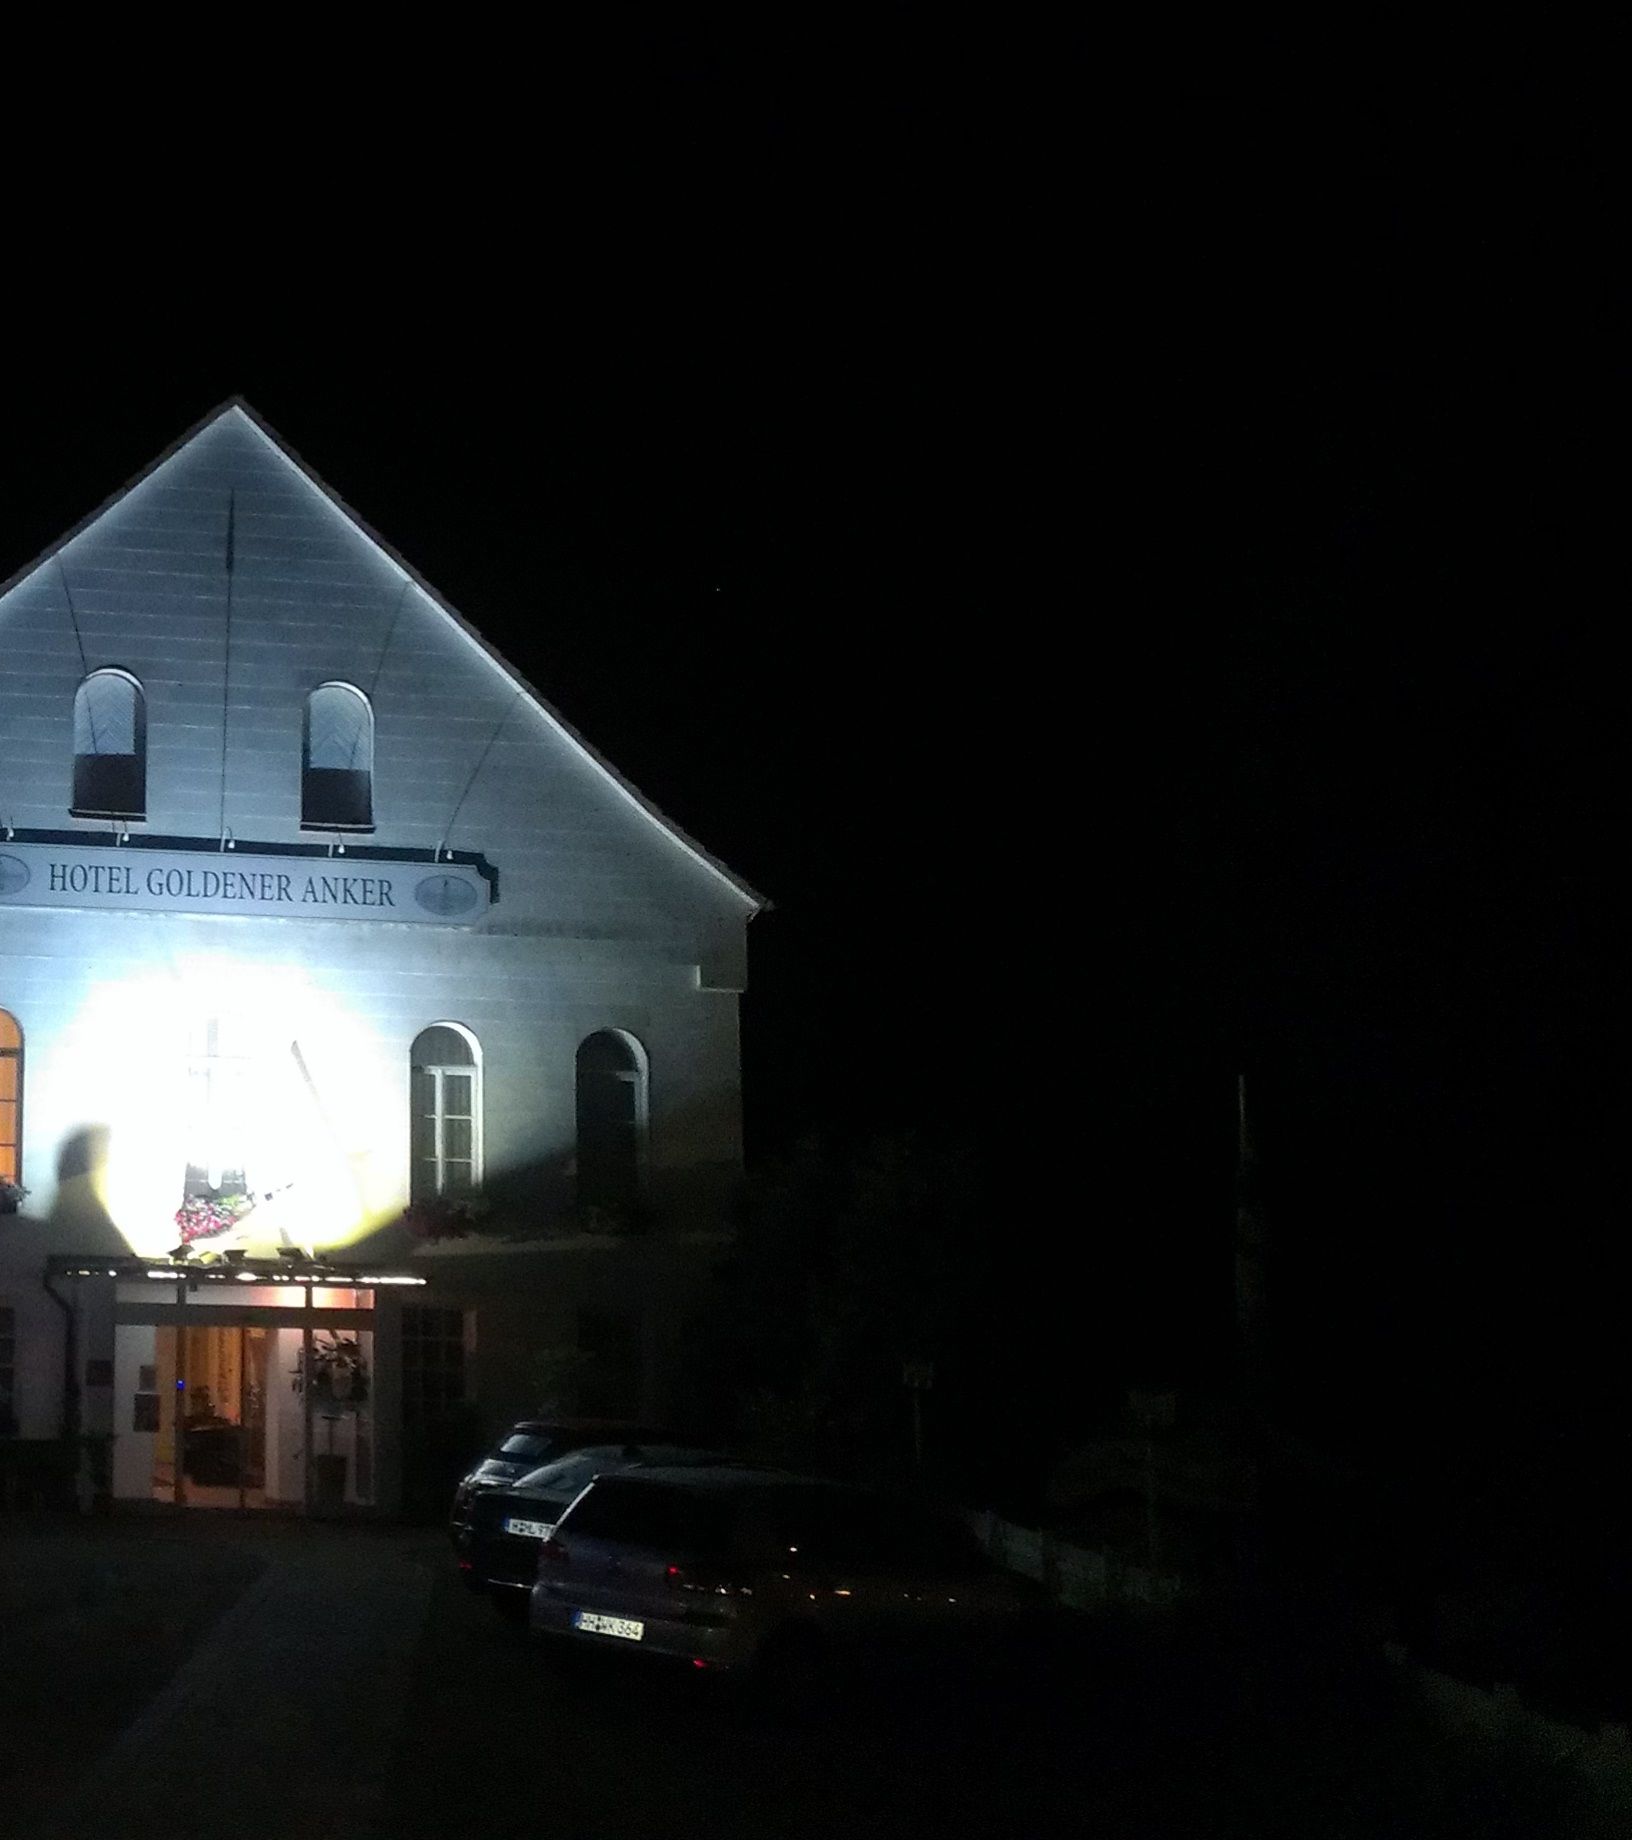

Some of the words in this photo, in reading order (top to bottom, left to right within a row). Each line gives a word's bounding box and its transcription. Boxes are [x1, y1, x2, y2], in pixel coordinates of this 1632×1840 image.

[49, 863, 139, 895] HOTEL
[146, 868, 293, 902] GOLDENER
[301, 876, 396, 907] ANKER
